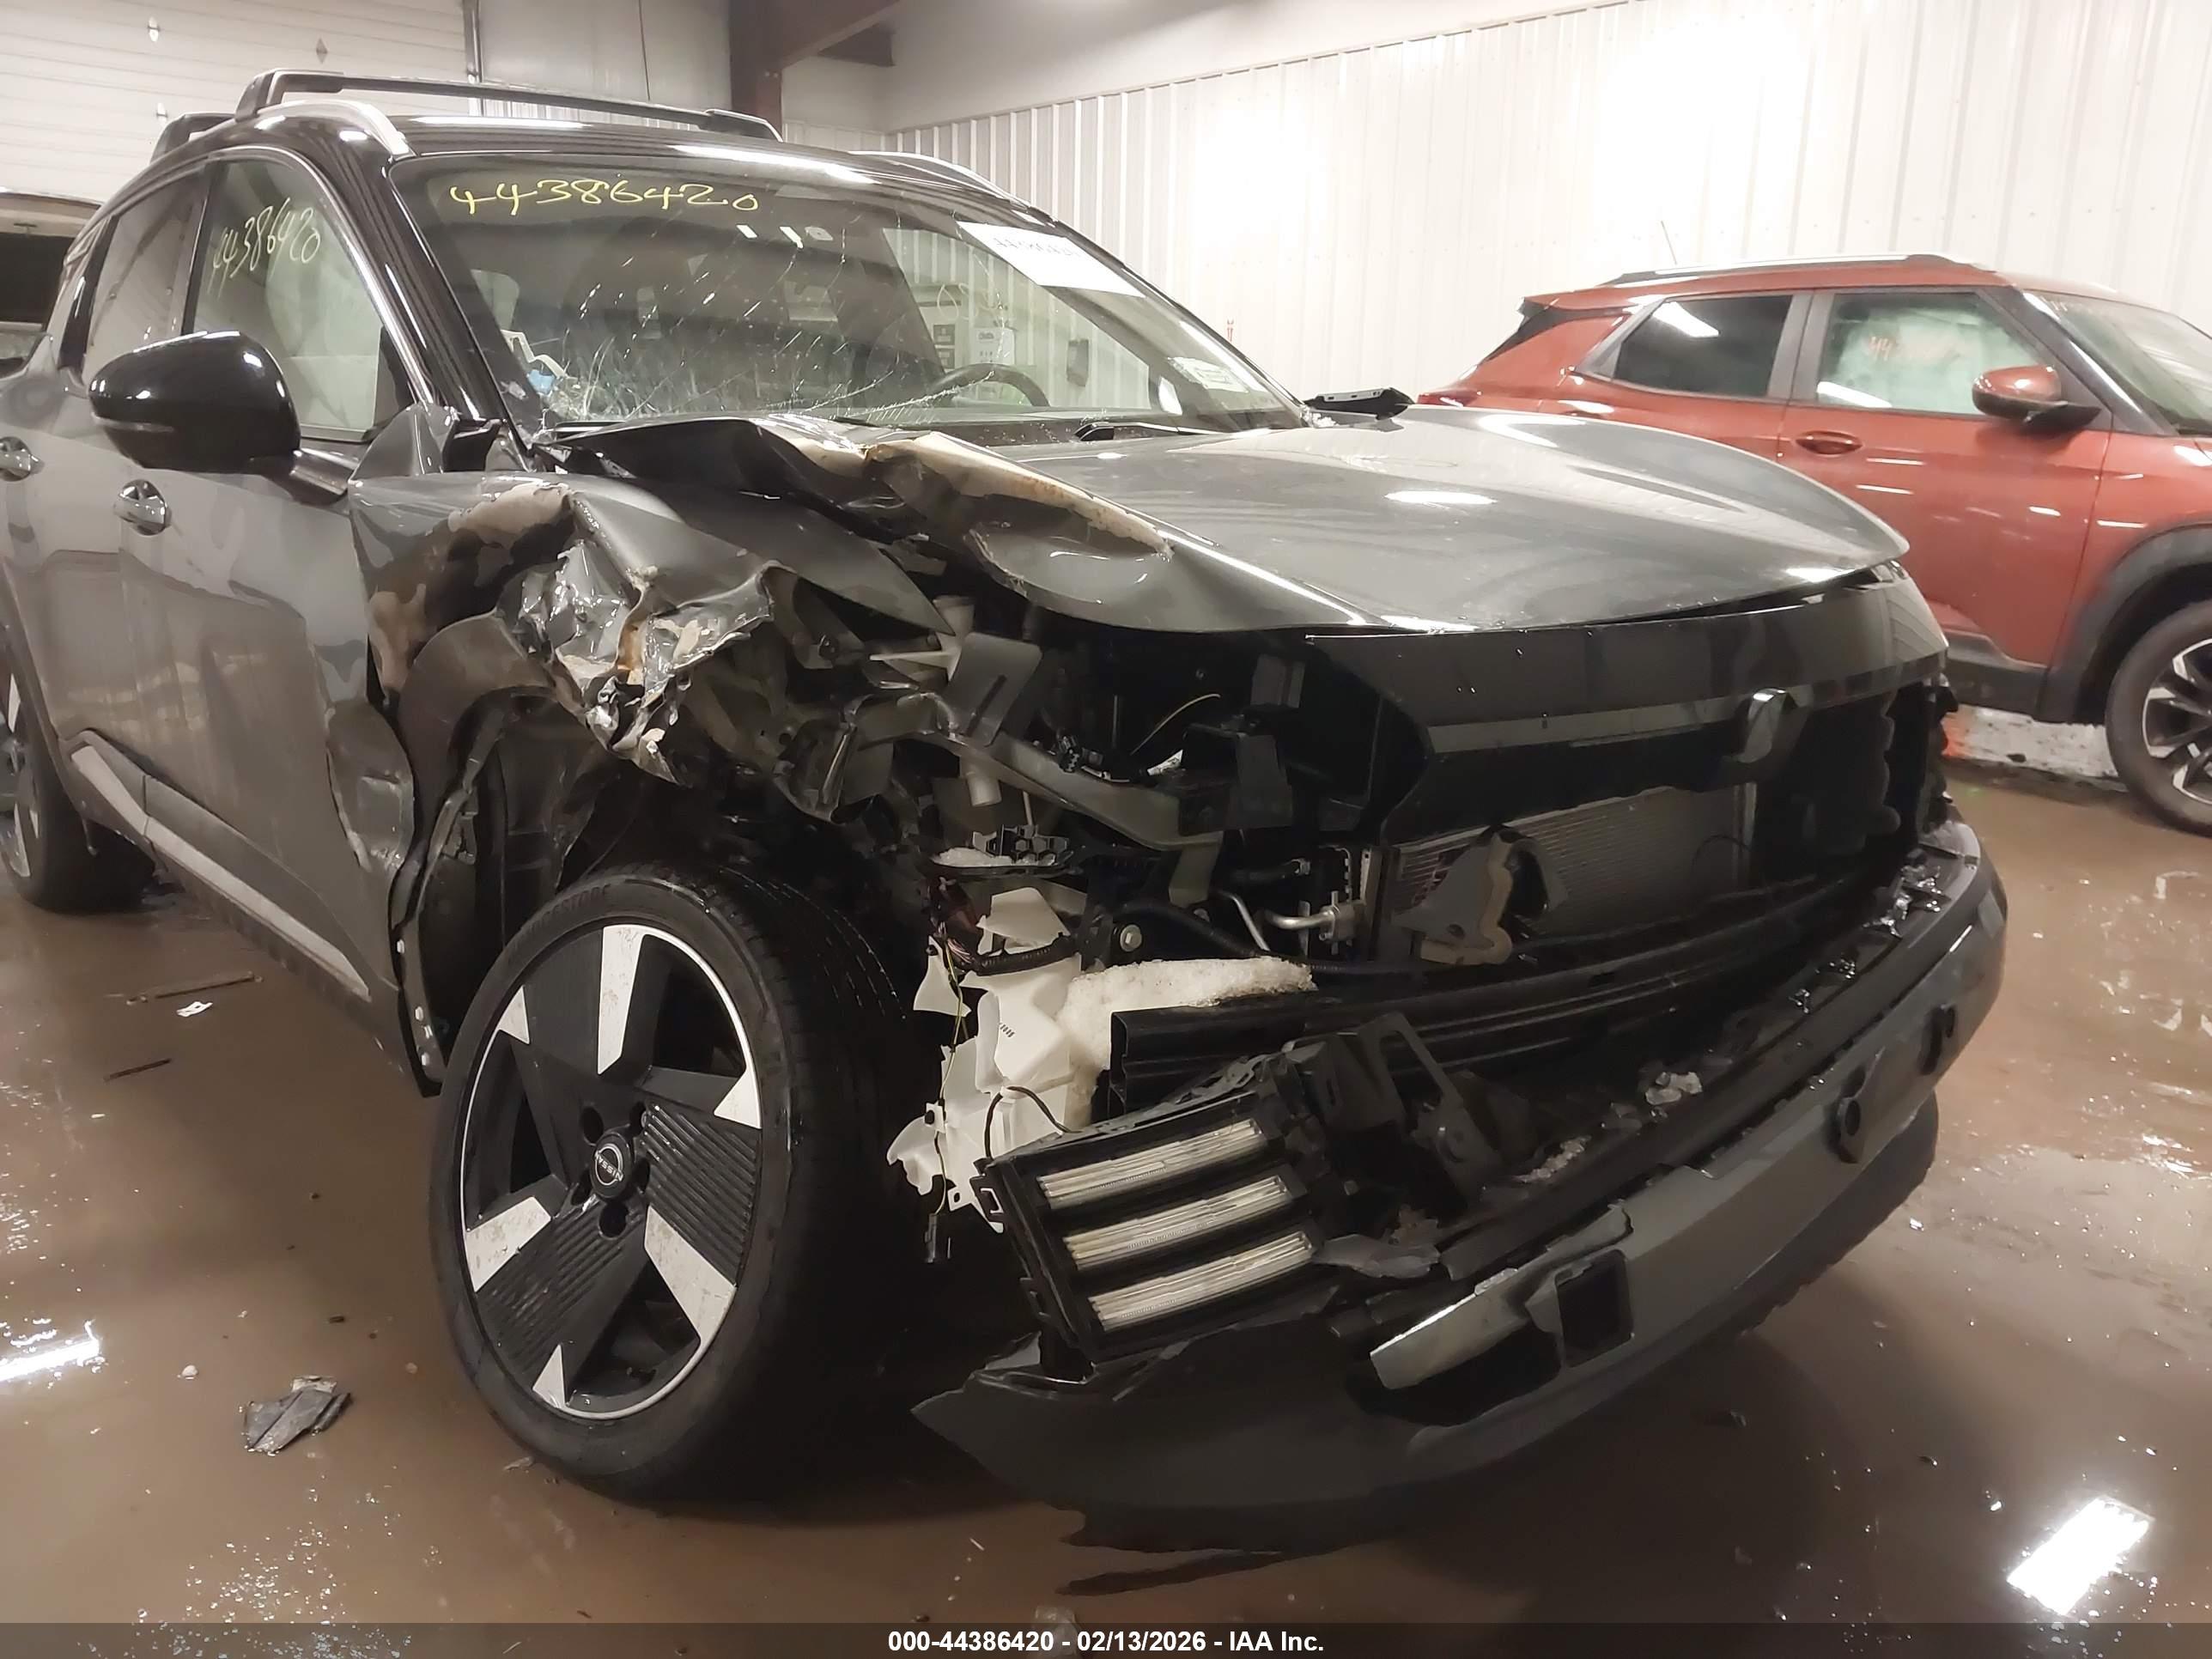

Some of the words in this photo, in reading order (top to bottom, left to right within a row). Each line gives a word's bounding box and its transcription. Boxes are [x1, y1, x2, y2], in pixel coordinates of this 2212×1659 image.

[449, 178, 759, 216] 44386420
[206, 197, 321, 299] 44386420
[594, 1150, 624, 1182] NISSAN
